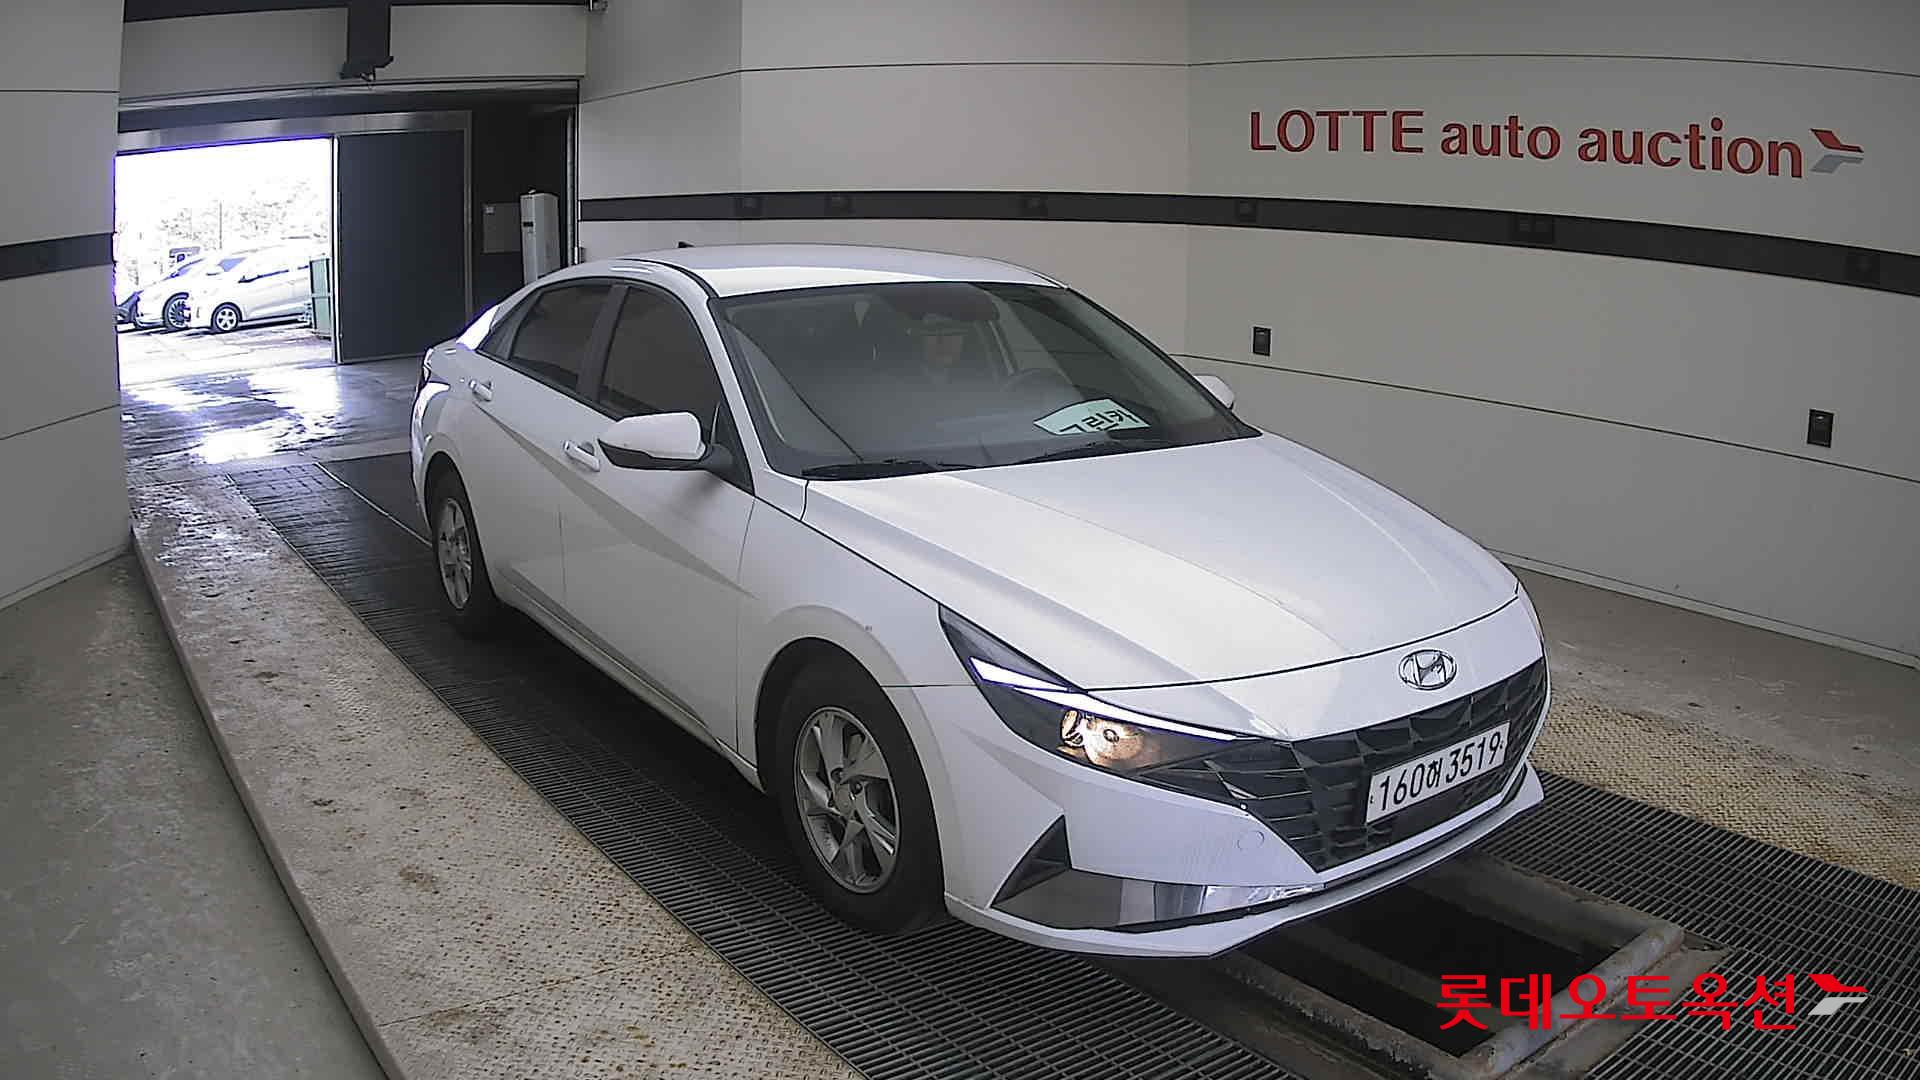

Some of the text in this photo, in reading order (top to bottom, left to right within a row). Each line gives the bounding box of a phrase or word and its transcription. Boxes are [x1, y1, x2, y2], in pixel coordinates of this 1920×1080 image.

[1251, 110, 1803, 178] LOTTE auto auction
